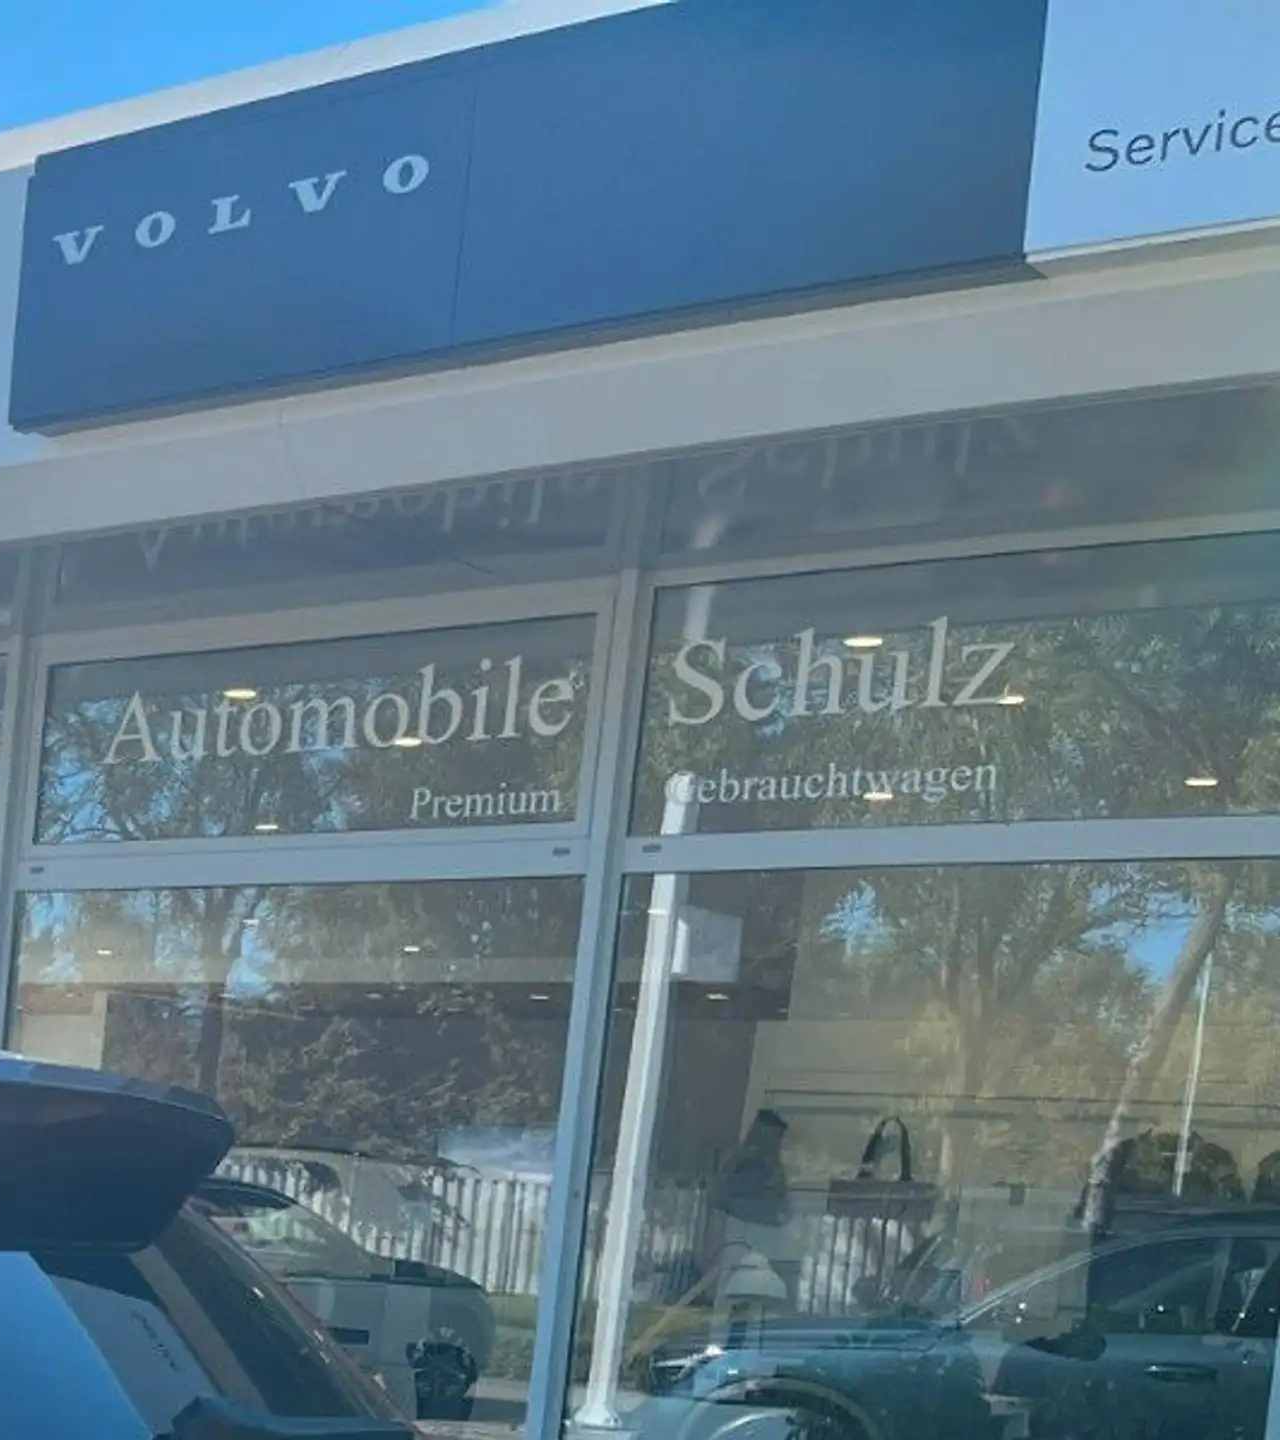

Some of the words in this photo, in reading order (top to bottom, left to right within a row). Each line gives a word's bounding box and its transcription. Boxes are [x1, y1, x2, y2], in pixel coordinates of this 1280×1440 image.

[52, 154, 429, 265] VOLVO
[101, 655, 575, 765] Automobile
[668, 616, 1016, 727] Schulz
[408, 784, 561, 820] Premium
